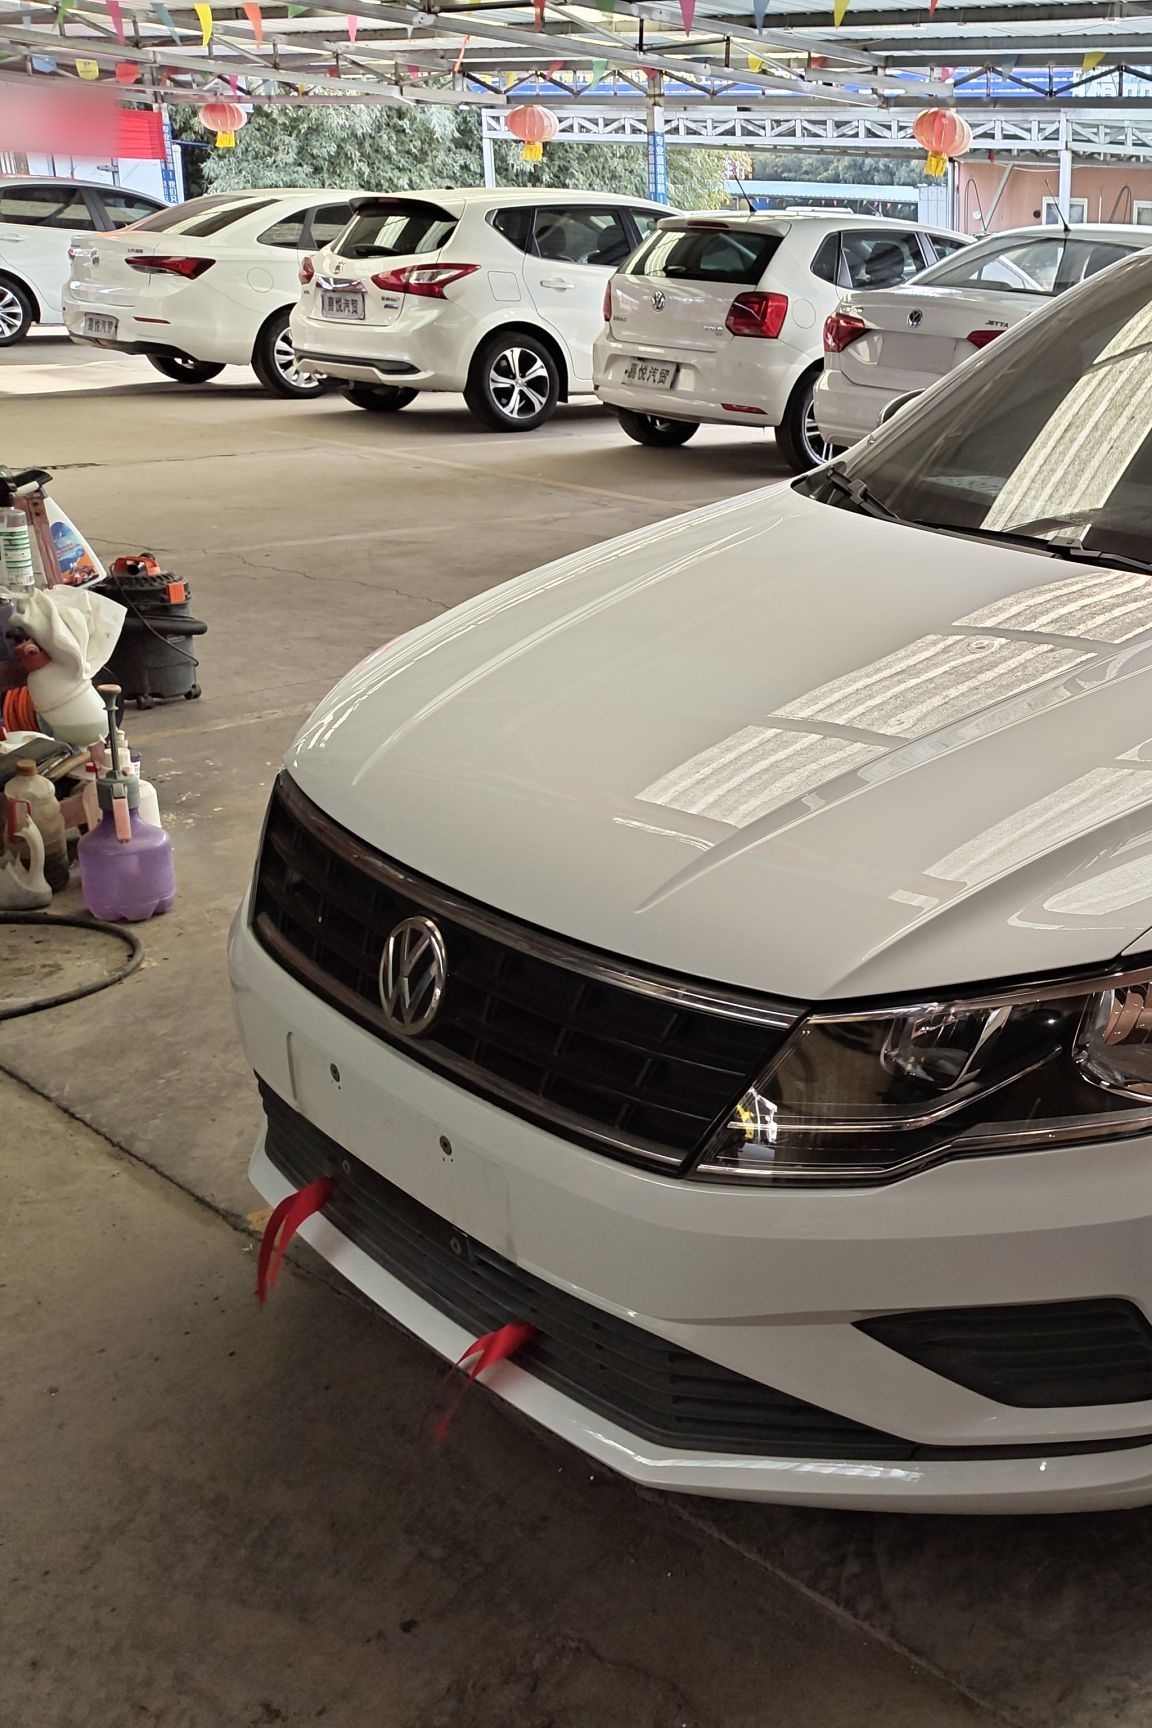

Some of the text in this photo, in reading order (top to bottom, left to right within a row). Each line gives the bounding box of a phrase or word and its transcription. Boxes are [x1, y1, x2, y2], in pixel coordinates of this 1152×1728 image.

[984, 320, 1009, 328] JETTA
[626, 362, 670, 385] 喜悦汽贸
